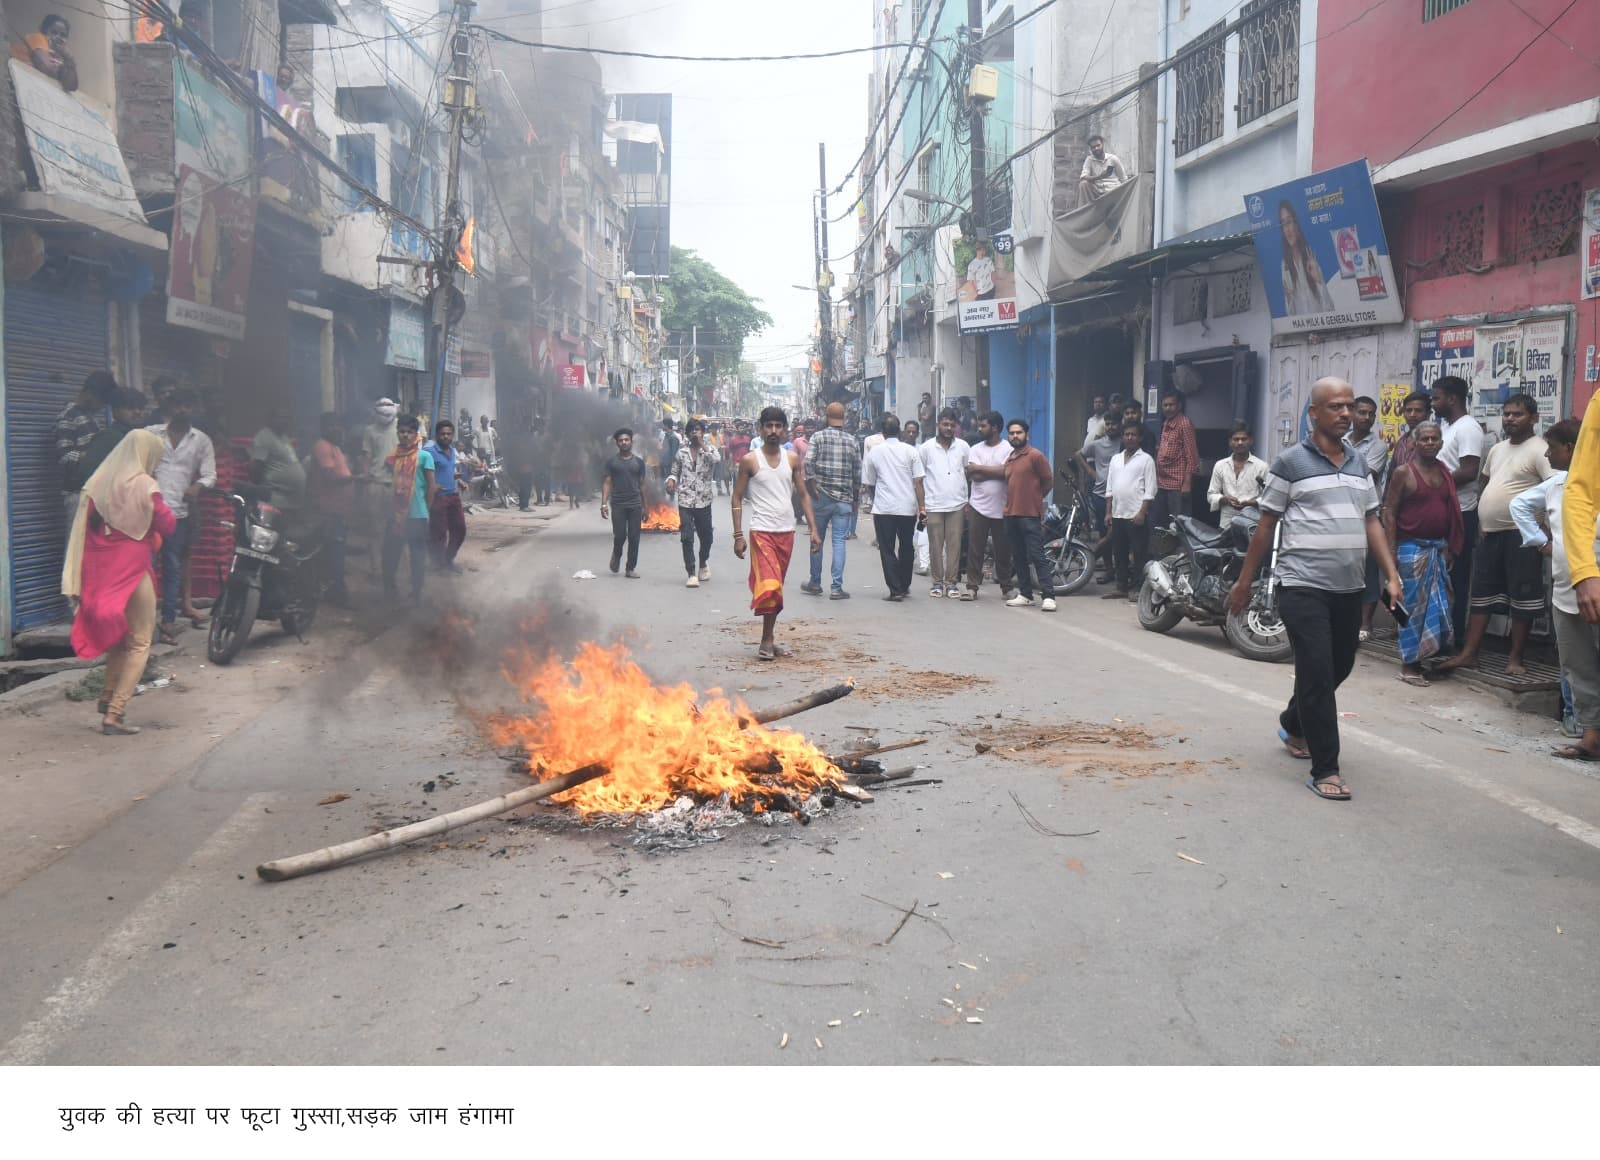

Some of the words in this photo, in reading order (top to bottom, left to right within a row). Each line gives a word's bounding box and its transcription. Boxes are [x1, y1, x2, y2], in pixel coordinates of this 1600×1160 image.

[1292, 319, 1306, 329] MAA
[1306, 316, 1319, 328] MILK
[1325, 313, 1354, 326] GENERAL
[1354, 310, 1377, 323] STORE
[1526, 349, 1551, 371] डिजिटल
